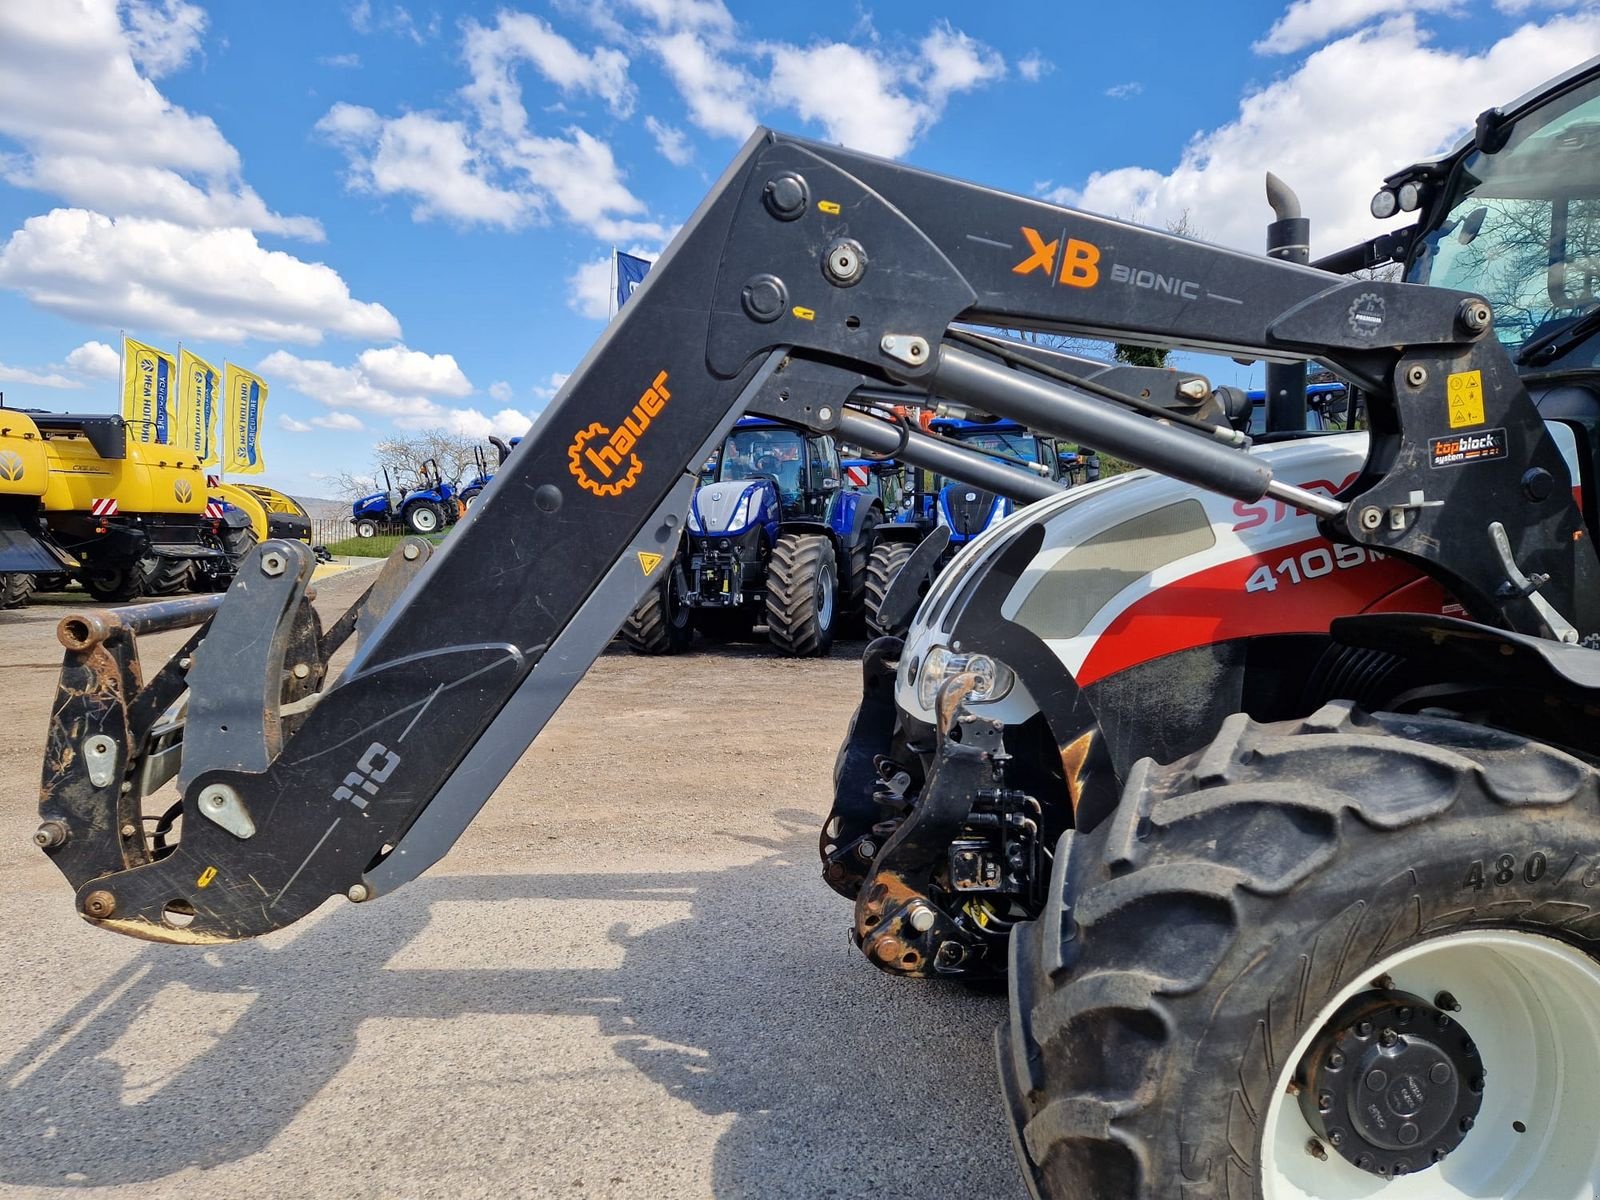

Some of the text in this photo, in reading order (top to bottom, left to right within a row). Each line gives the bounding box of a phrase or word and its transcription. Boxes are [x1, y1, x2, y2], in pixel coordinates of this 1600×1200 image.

[1110, 263, 1200, 300] BIONIC
[239, 382, 248, 445] NEW HOLLAND
[248, 399, 257, 447] AGRICULTURE
[584, 369, 671, 478] hauer
[1434, 452, 1464, 464] system
[1435, 433, 1495, 456] topblock
[1244, 543, 1366, 593] 4105
[331, 742, 401, 809] 110
